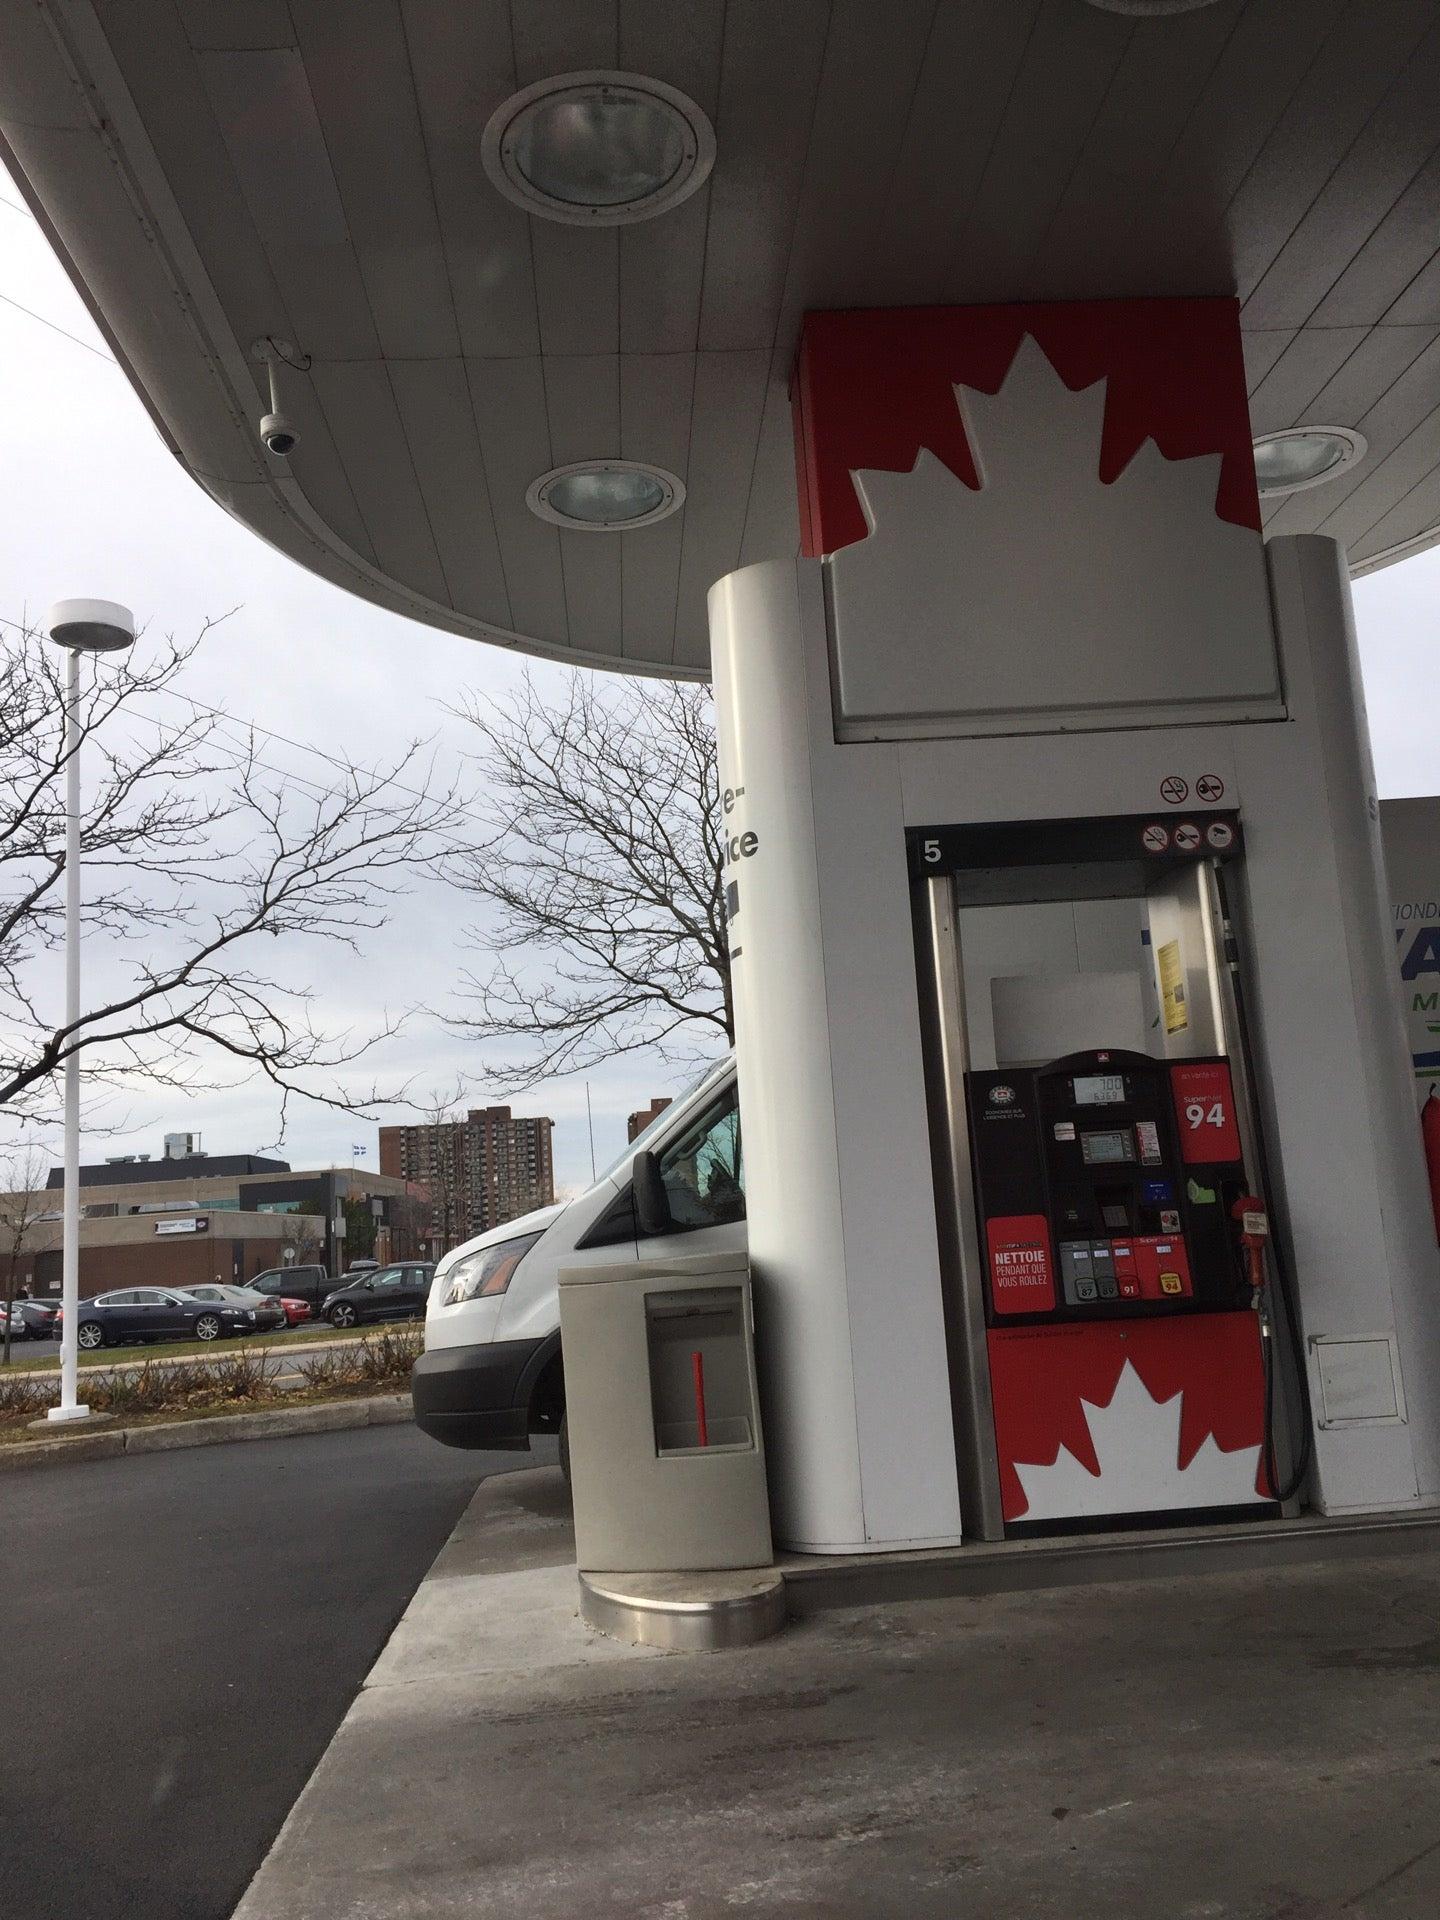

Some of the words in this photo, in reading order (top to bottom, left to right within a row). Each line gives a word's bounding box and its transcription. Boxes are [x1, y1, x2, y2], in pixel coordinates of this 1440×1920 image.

[722, 787, 745, 814] e-
[724, 829, 759, 866] ice
[924, 839, 942, 863] 5
[1392, 902, 1440, 920] IOND
[1186, 1103, 1226, 1129] 94
[995, 1250, 1045, 1265] NETTOIE
[996, 1264, 1031, 1276] PENDANT
[1031, 1263, 1047, 1274] QUE
[997, 1277, 1018, 1288] VOUS
[1019, 1274, 1048, 1287] ROULEZ
[1123, 1286, 1135, 1295] 91
[1166, 1283, 1179, 1292] 94
